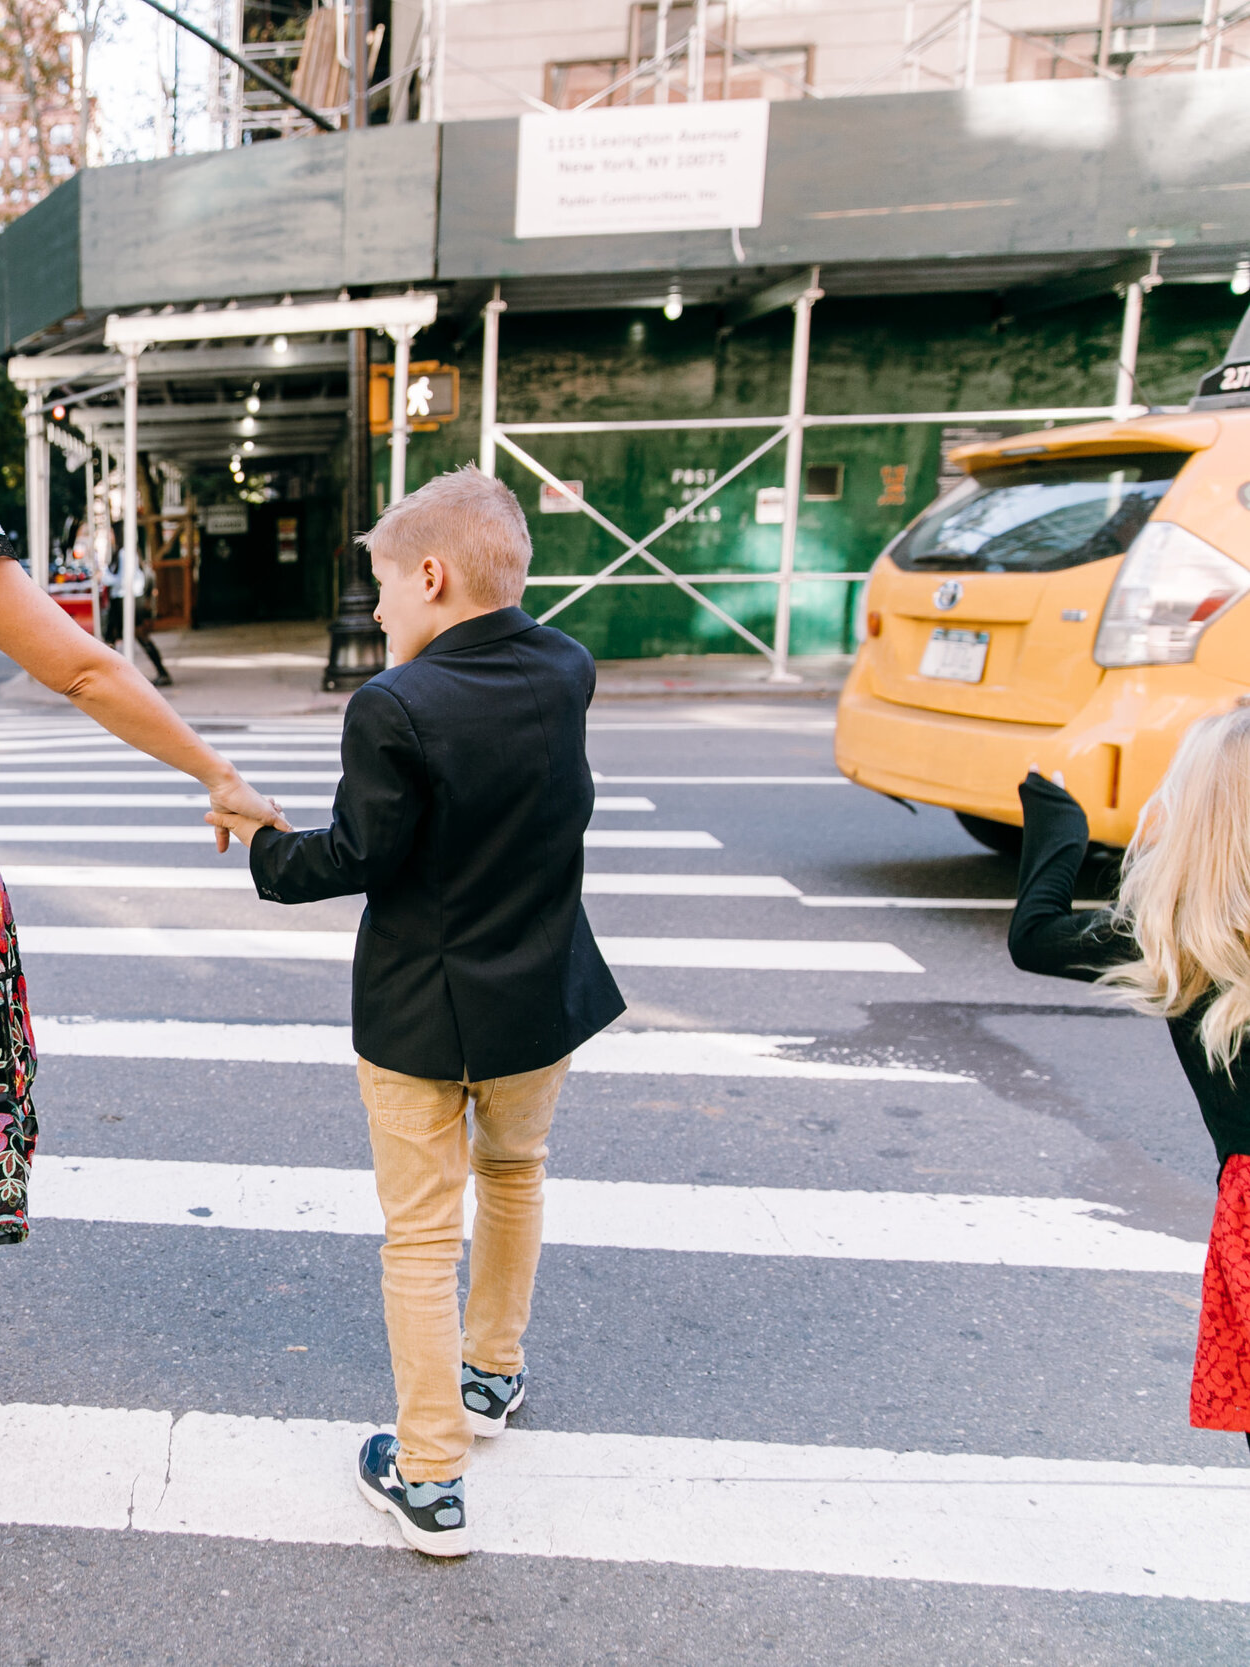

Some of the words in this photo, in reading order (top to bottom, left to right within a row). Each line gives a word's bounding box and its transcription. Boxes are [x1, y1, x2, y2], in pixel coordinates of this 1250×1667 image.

[592, 131, 673, 149] Lexington
[678, 129, 742, 145] Avenue
[557, 160, 595, 173] New
[646, 154, 671, 169] NY
[671, 468, 717, 485] POST
